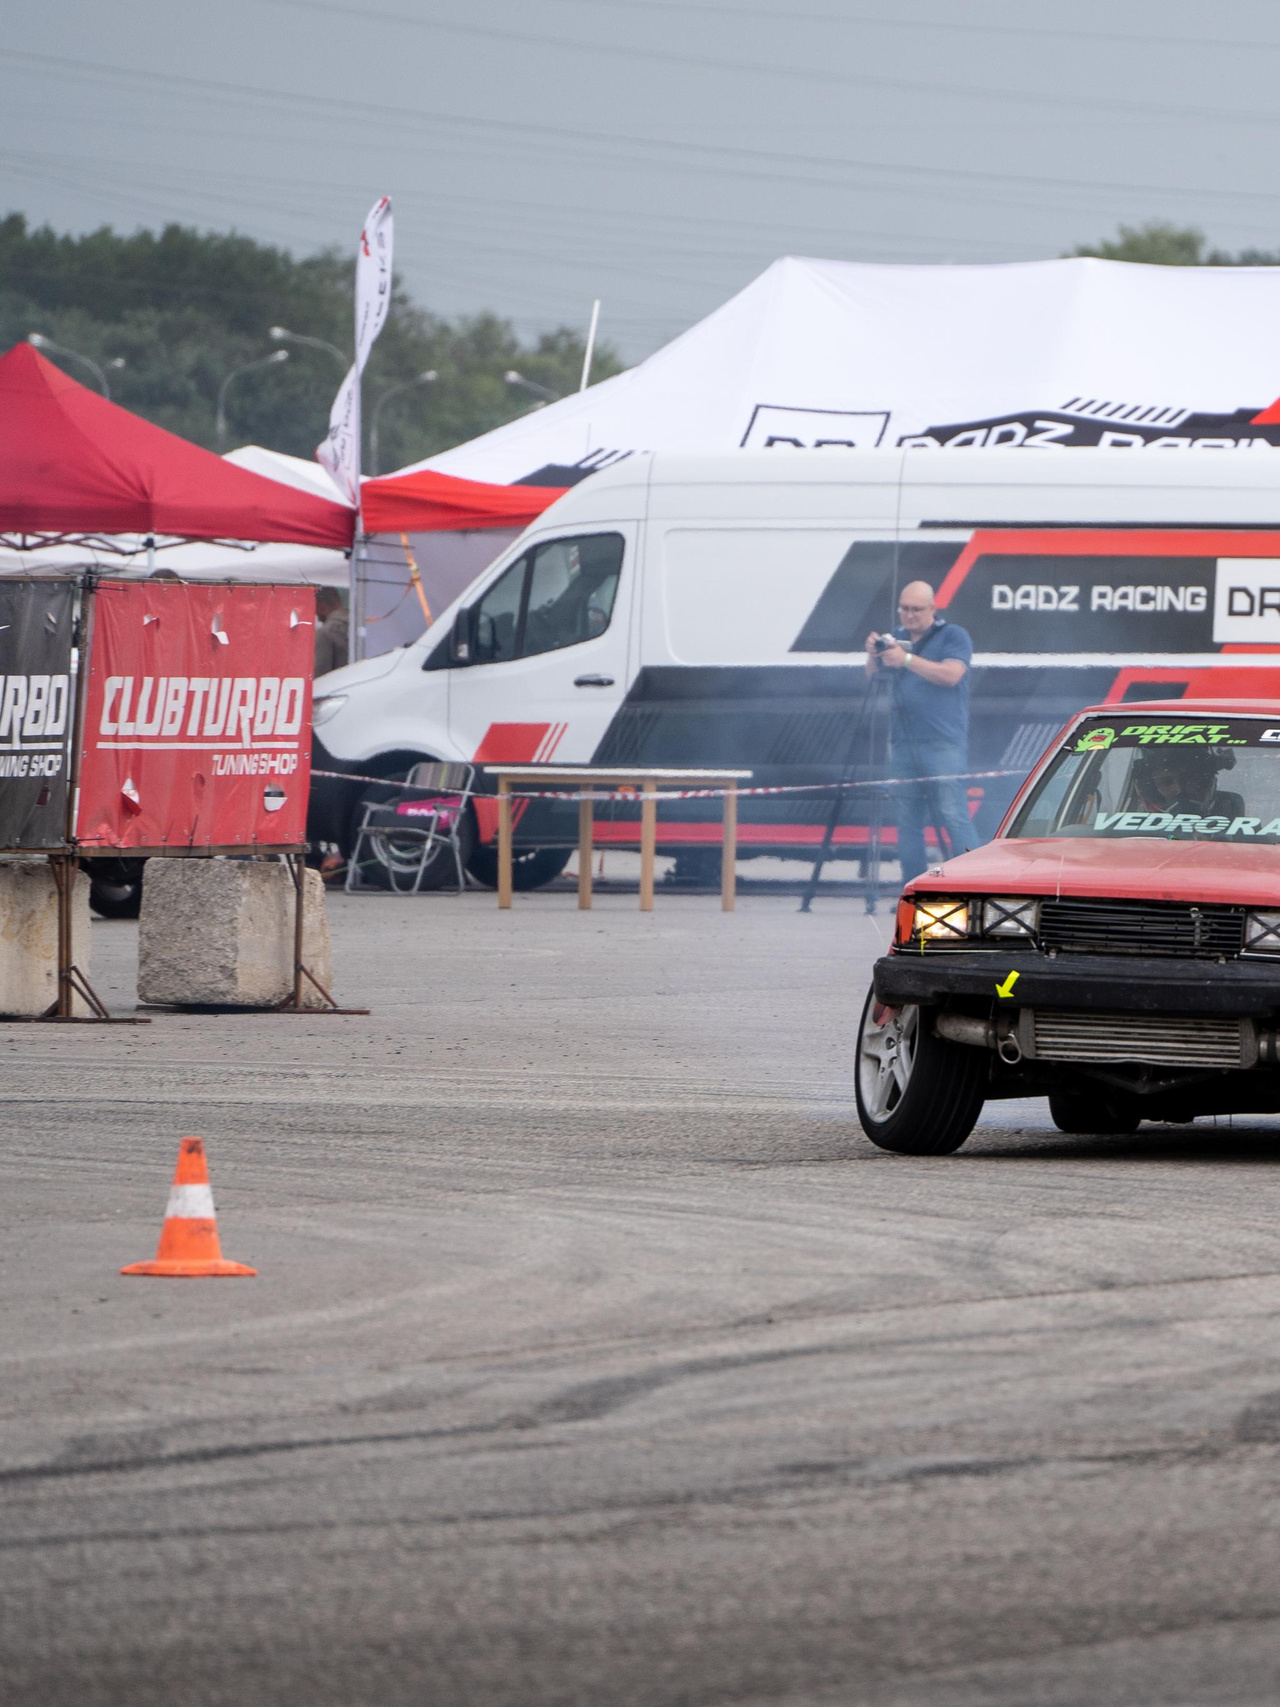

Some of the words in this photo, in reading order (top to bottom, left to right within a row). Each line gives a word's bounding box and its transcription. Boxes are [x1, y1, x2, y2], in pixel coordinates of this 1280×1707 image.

[991, 584, 1080, 611] DADZ
[1090, 585, 1208, 612] RACING
[0, 675, 69, 749] RBO
[99, 676, 305, 749] CLUBTURBO
[1119, 724, 1231, 736] DRIFT
[29, 754, 63, 777] SHOP
[211, 754, 260, 775] TUNING
[258, 753, 298, 775] SHOP
